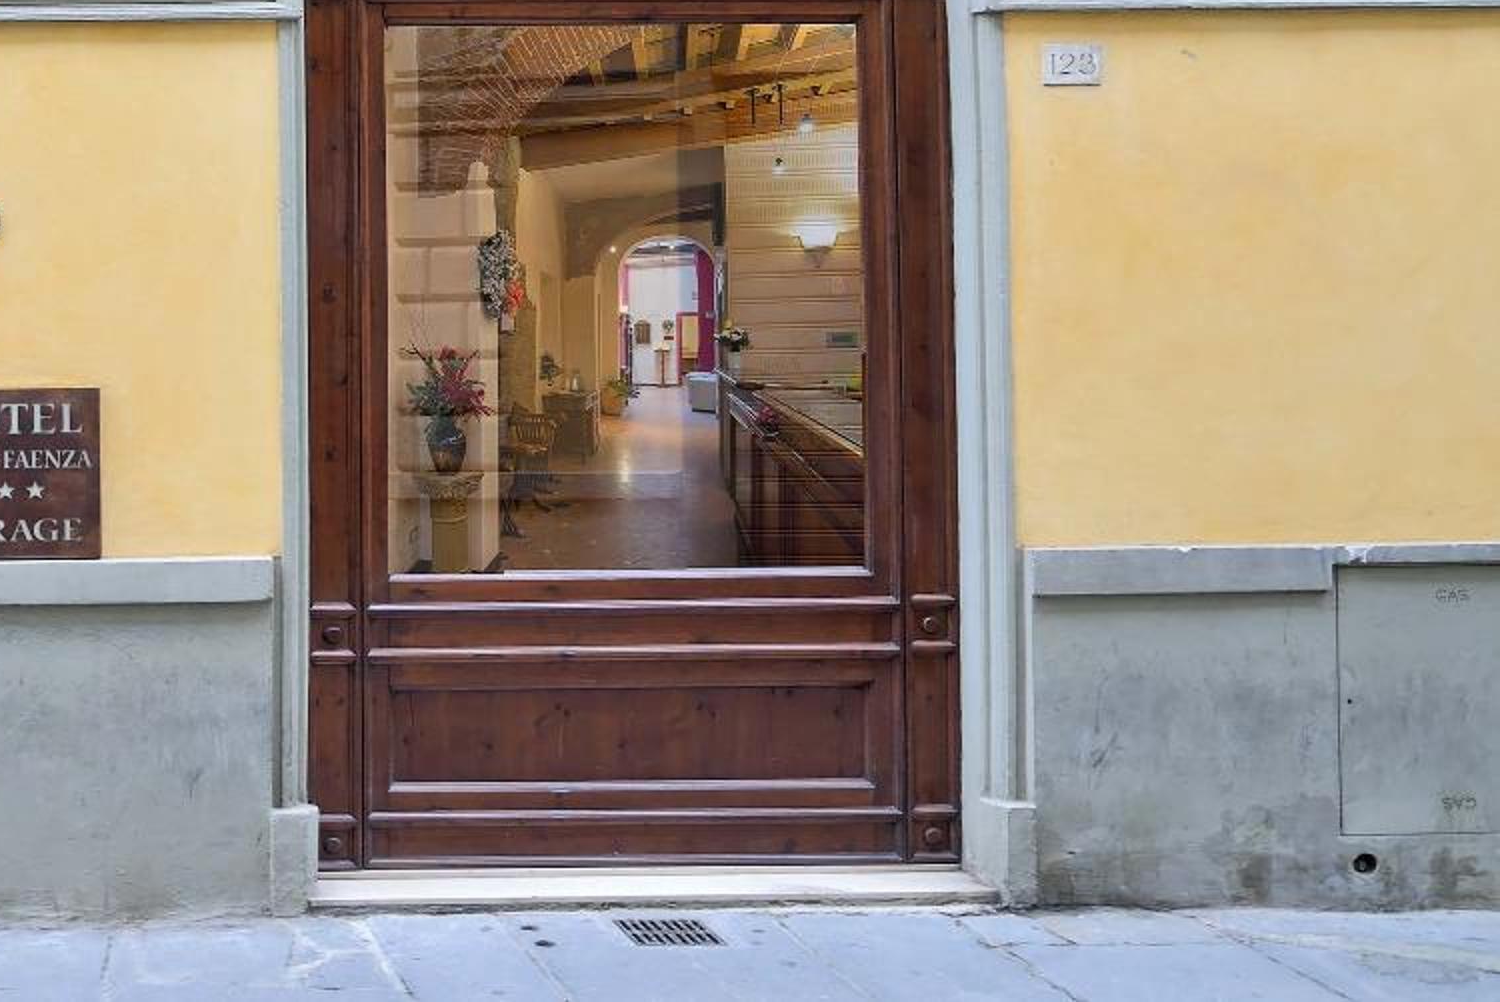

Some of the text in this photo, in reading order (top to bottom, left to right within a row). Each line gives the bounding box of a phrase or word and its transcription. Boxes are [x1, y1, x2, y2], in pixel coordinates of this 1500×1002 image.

[1050, 53, 1097, 75] 123
[3, 449, 92, 470] FAENZA
[1435, 588, 1471, 603] GAS
